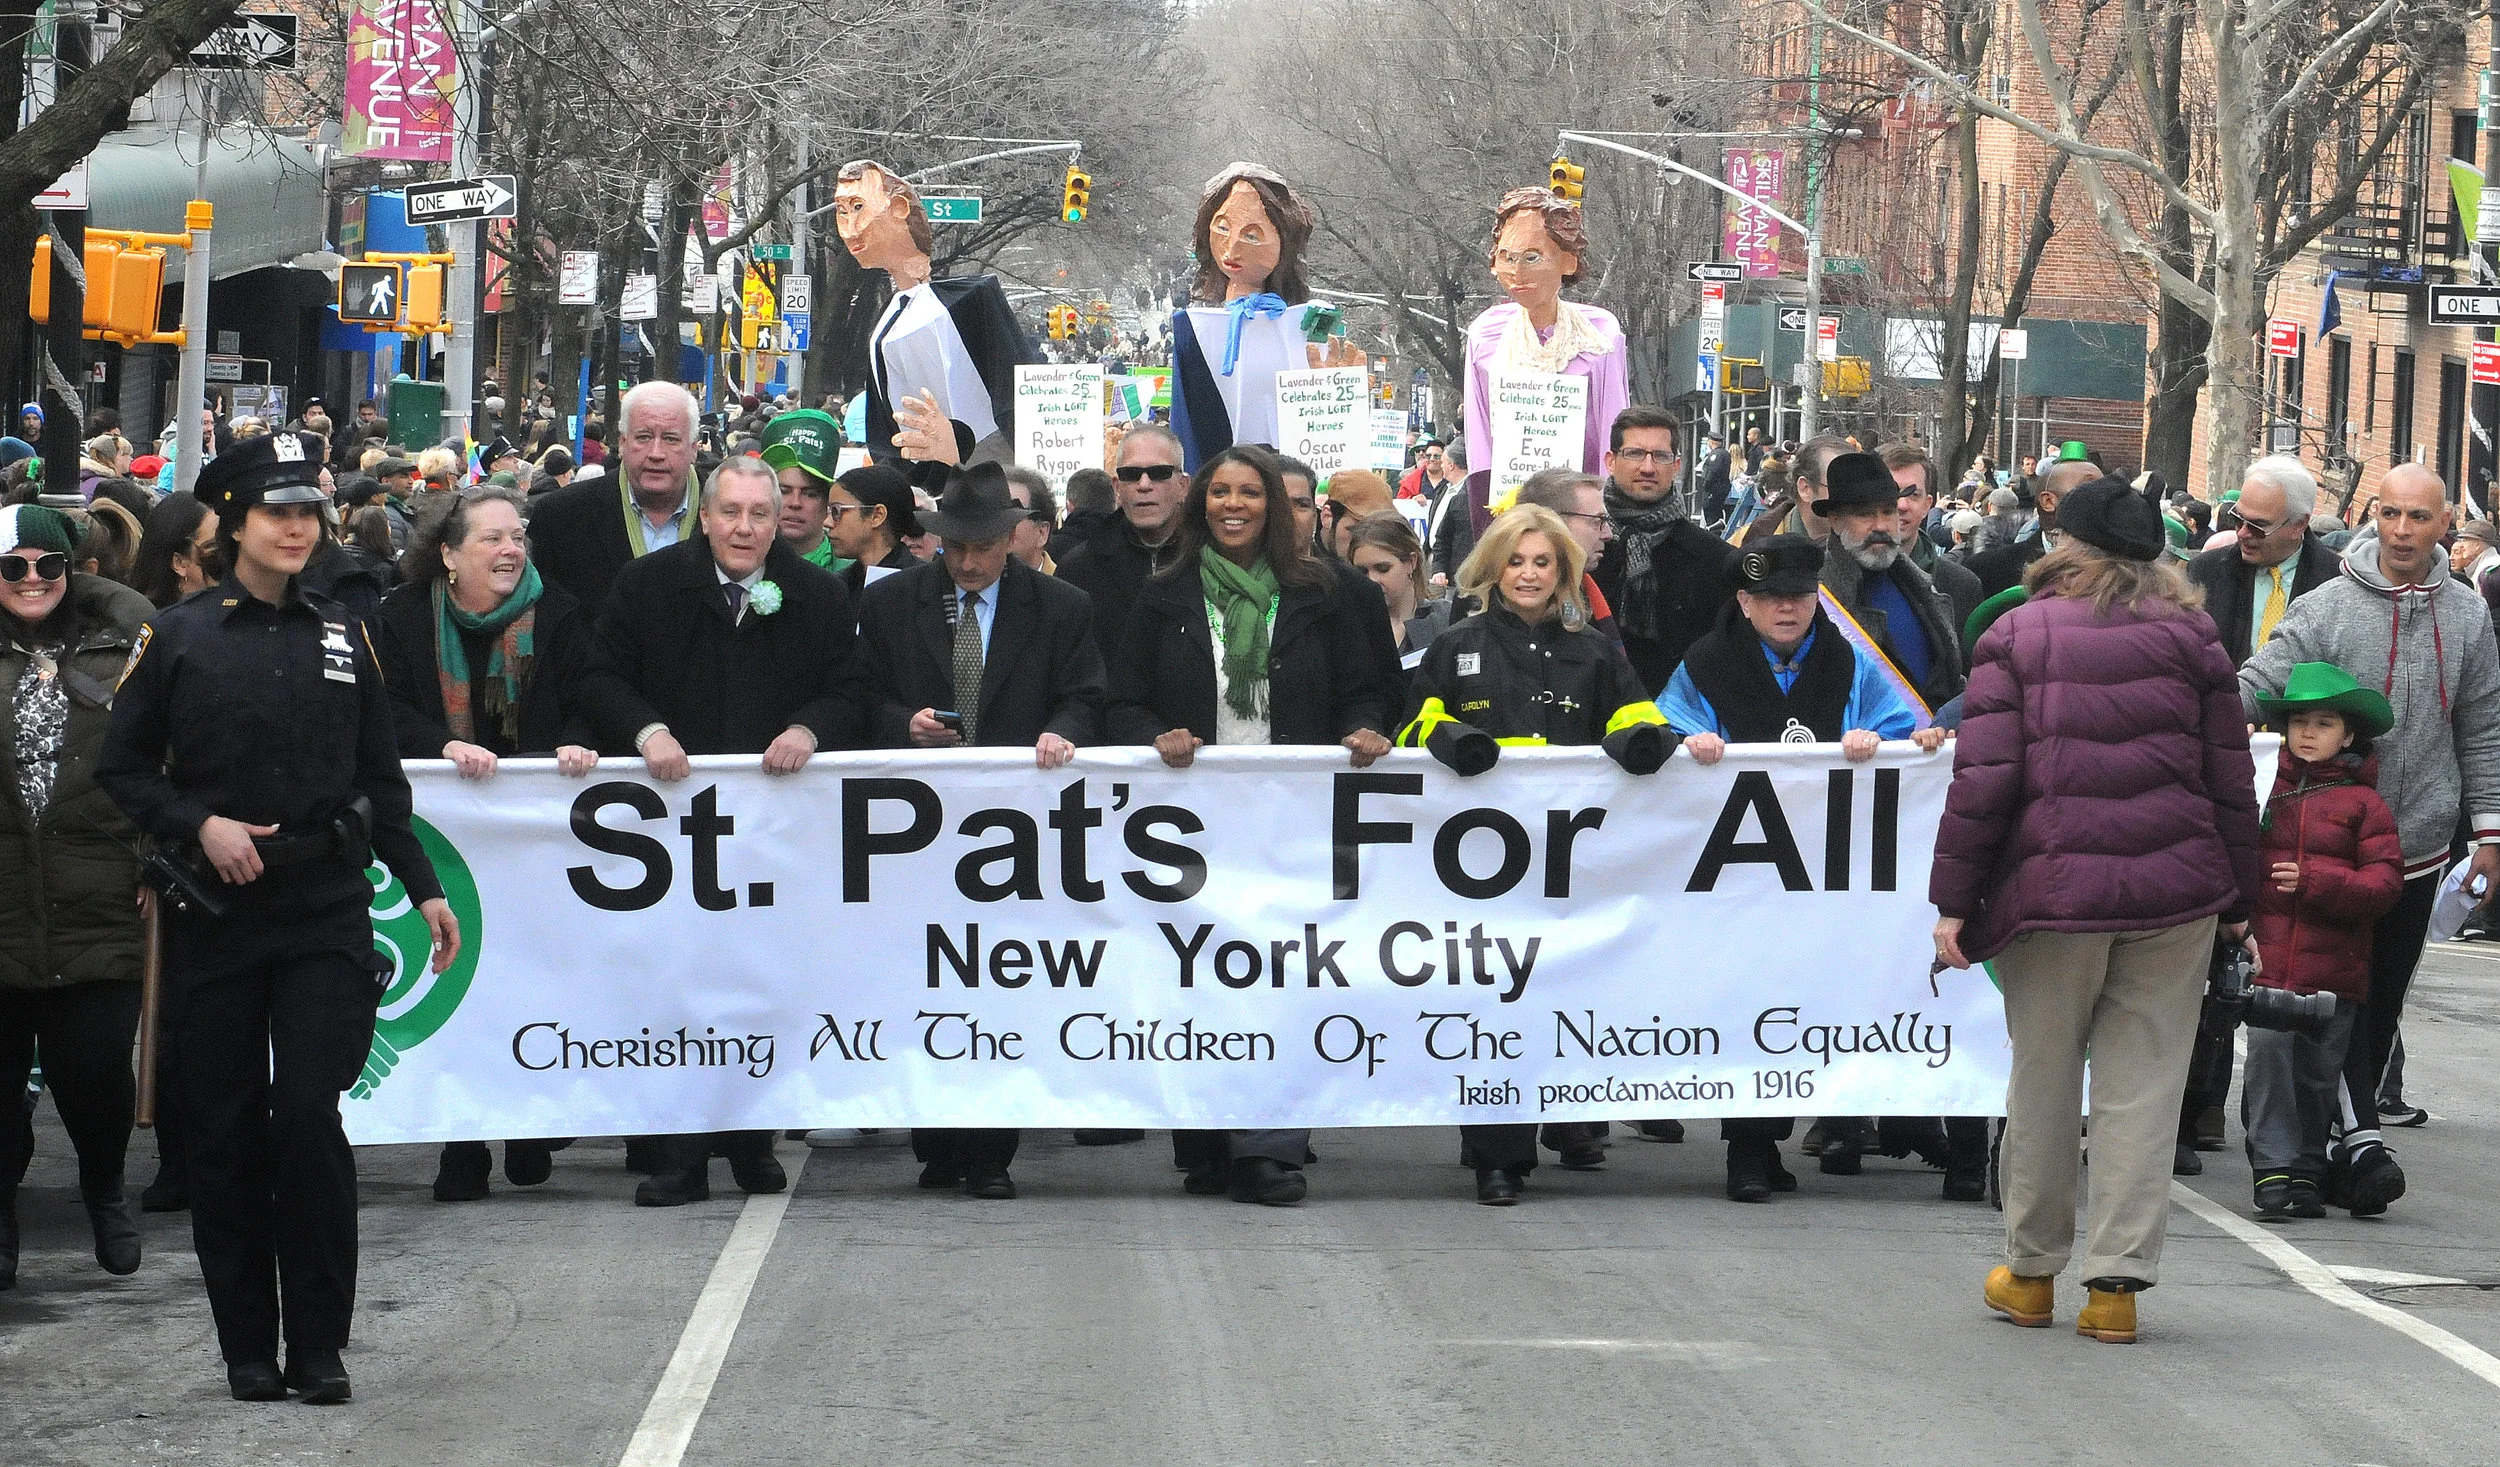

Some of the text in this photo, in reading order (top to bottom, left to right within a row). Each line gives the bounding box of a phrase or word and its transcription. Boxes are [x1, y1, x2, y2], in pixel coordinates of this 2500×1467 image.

[415, 188, 498, 212] ONE WAY
[932, 201, 953, 217] St
[763, 246, 774, 258] 50
[1698, 268, 1737, 277] ONE WAY
[1833, 260, 1846, 272] 50
[786, 295, 807, 309] 20
[2447, 298, 2481, 313] ONE
[1788, 315, 1806, 324] ONE
[1703, 328, 1720, 336] LIMIT
[1023, 368, 1067, 382] Lavender
[1075, 369, 1101, 381] Green
[1279, 373, 1324, 388] Lavender
[1332, 371, 1361, 386] Green
[1018, 383, 1090, 396] Celebrates 25
[1500, 377, 1543, 391] Lavender
[1553, 379, 1580, 394] Green
[1281, 390, 1332, 403] Celebrates
[1335, 385, 1355, 402] 25
[1499, 392, 1545, 406] Celebrates
[1552, 395, 1570, 409] 25
[1037, 402, 1088, 413] Irish LGBT
[1298, 404, 1353, 417] Irish LGBT
[1044, 416, 1078, 426] Heroes
[1514, 411, 1569, 424] Irish LGBT
[791, 428, 817, 438] Happy
[1307, 421, 1344, 432] Heroes
[1523, 425, 1557, 437] Heroes
[782, 436, 796, 446] St.
[1032, 431, 1085, 449] Robert
[1299, 438, 1346, 456] Oscar
[1521, 437, 1551, 458] Eva
[1036, 454, 1081, 476] Rygor
[1461, 699, 1490, 712] CAROLYN
[567, 777, 773, 911] St.
[1333, 768, 1607, 900] For
[1685, 769, 1899, 892] All
[927, 921, 1540, 1002] New York City
[513, 1008, 1951, 1078] Cherishing All The Children Of The Nation Equally
[1459, 1071, 1813, 1112] Irish proclamation 1916
